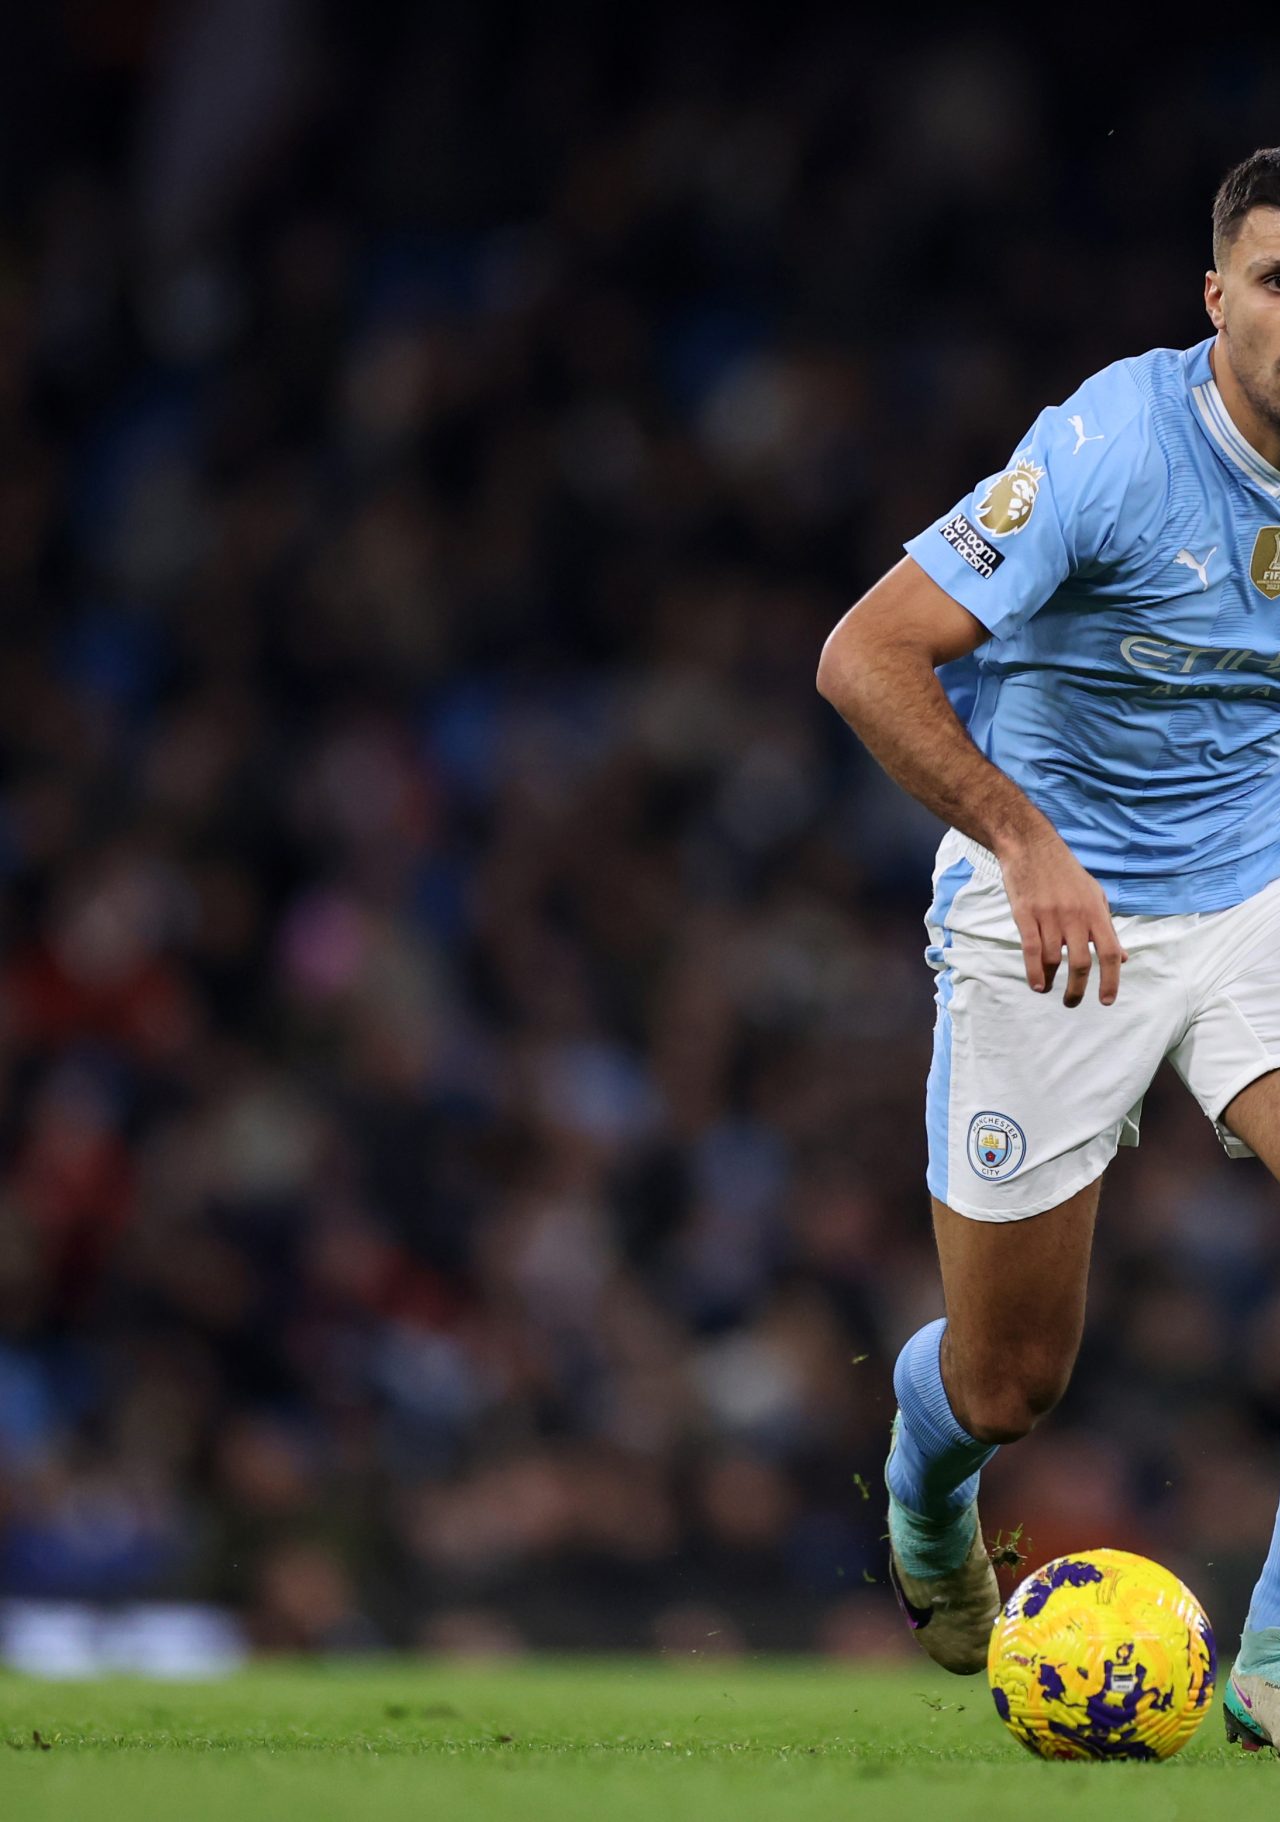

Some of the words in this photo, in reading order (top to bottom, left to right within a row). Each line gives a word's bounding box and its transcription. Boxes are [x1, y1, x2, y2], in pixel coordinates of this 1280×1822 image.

[939, 522, 960, 542] for
[953, 538, 993, 579] racism
[950, 513, 968, 534] No
[962, 529, 997, 564] room
[972, 1116, 1019, 1140] MANCHESTER
[981, 1168, 1000, 1177] CITY
